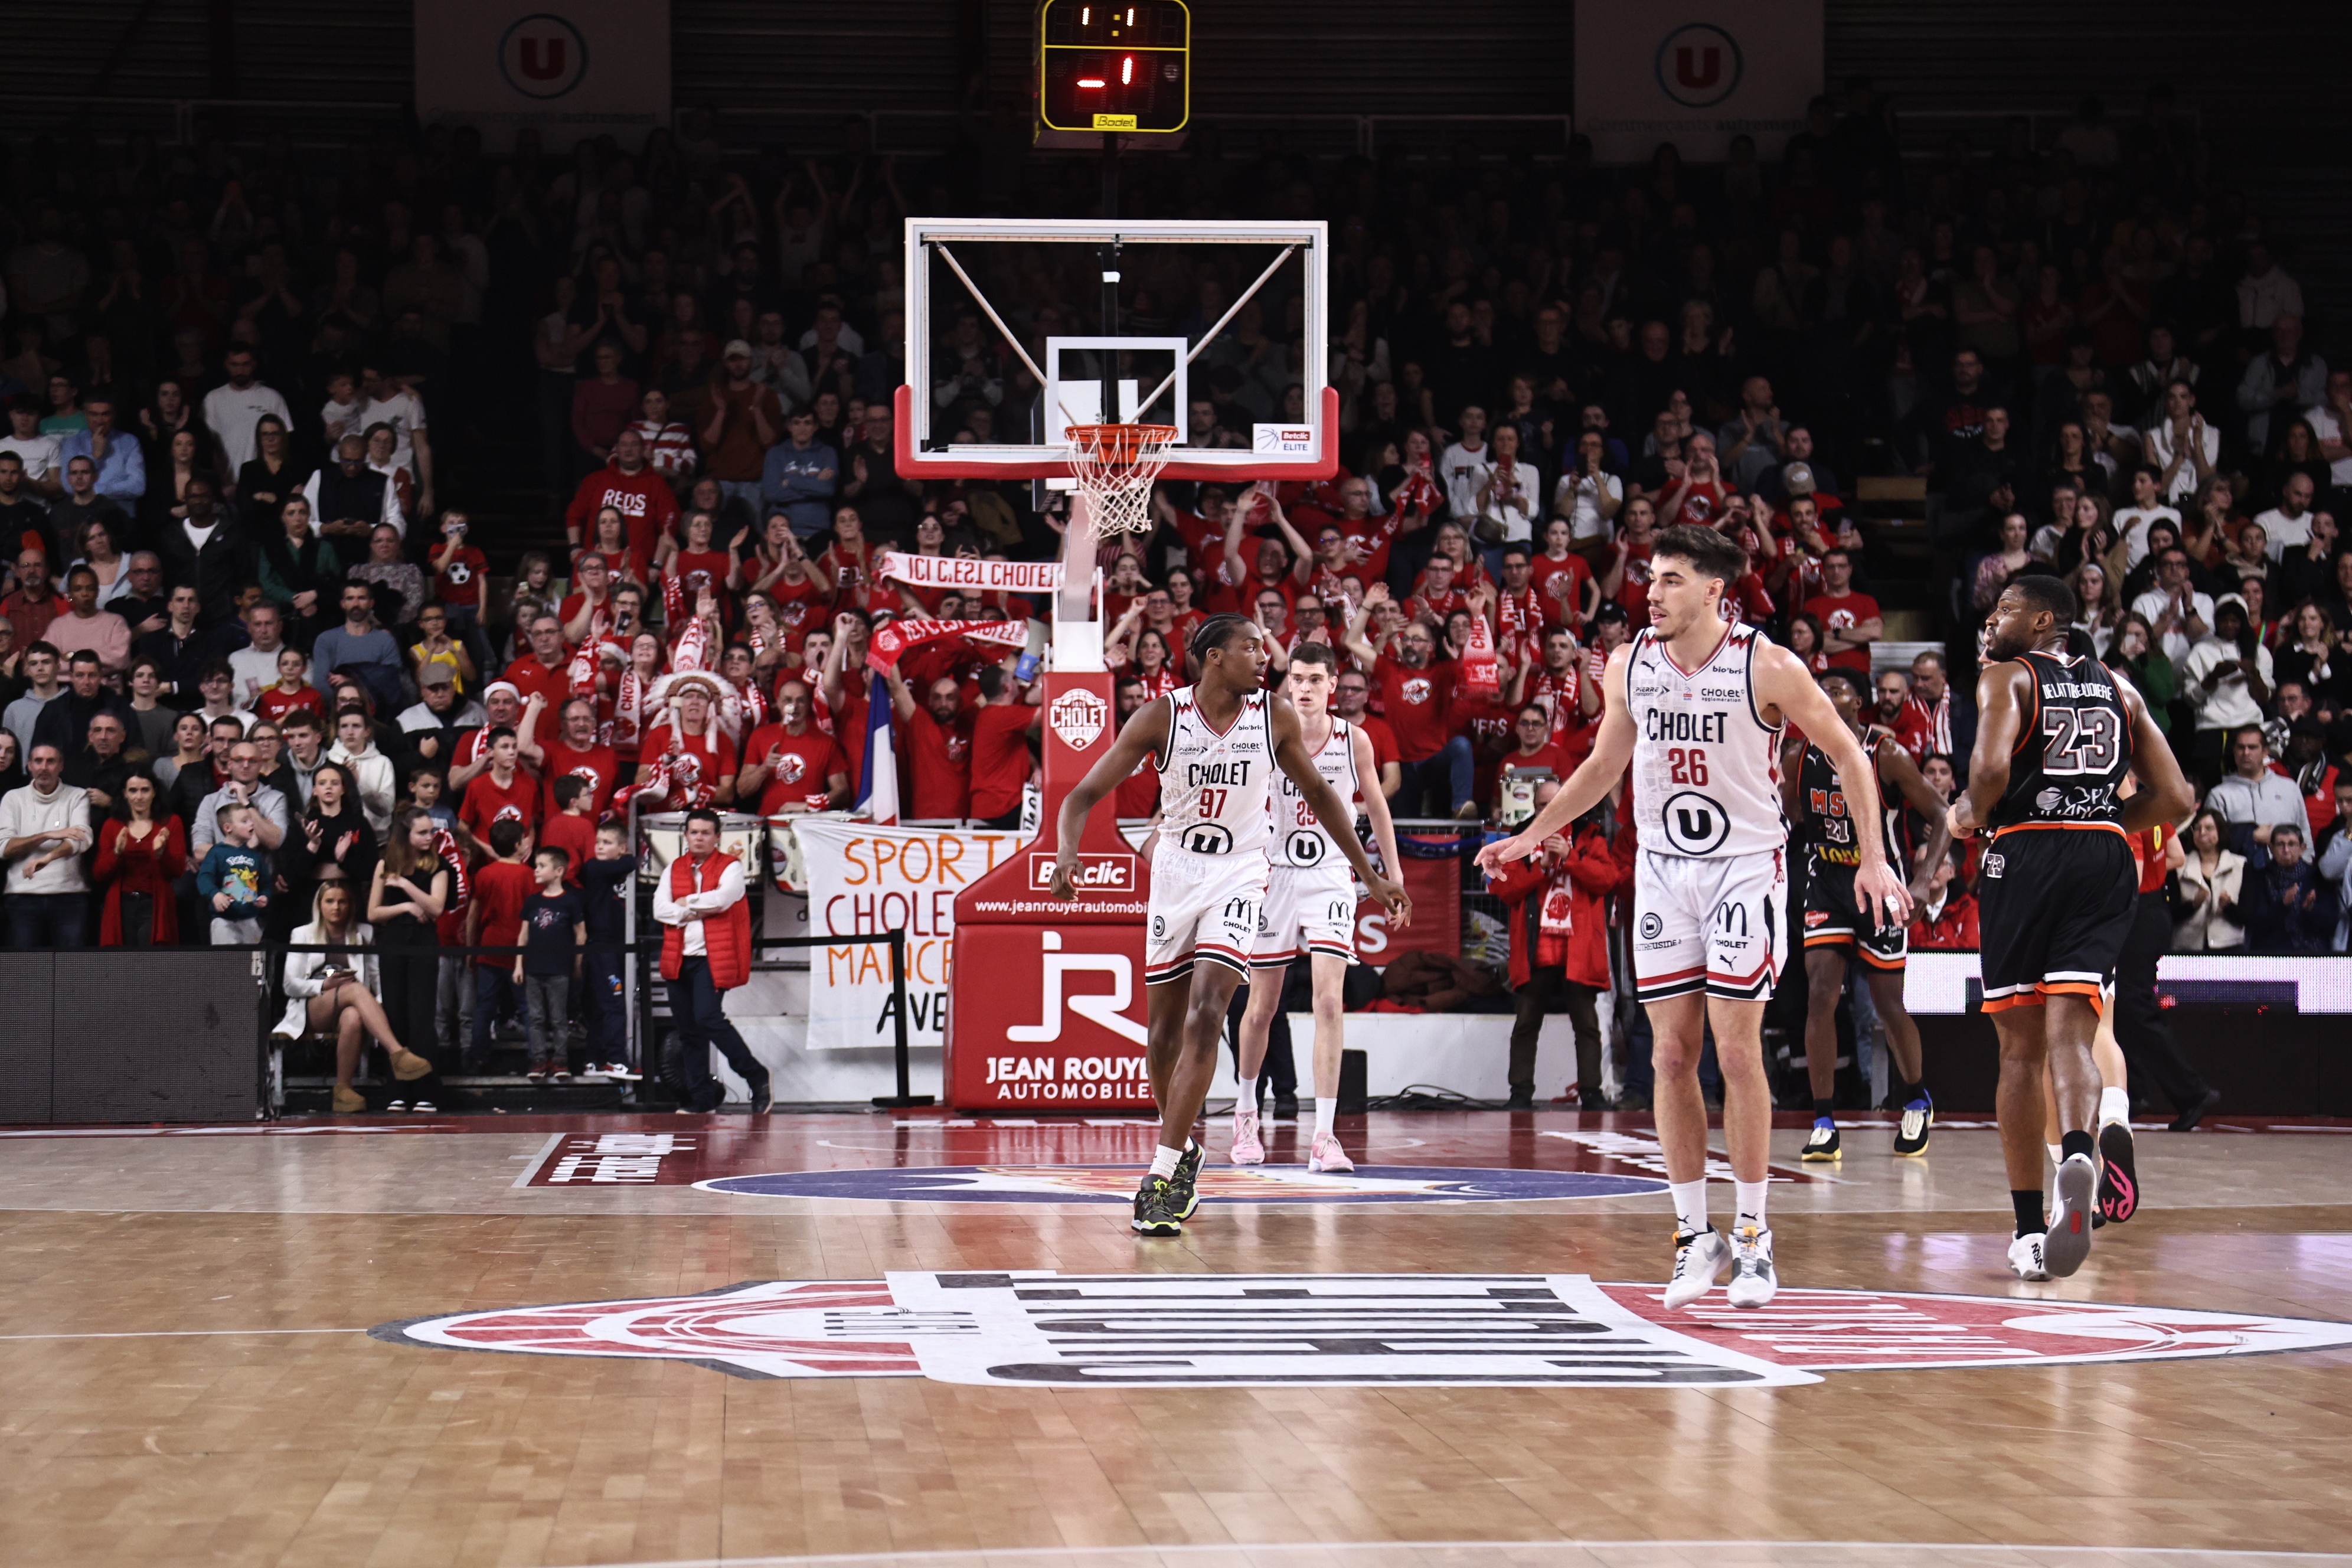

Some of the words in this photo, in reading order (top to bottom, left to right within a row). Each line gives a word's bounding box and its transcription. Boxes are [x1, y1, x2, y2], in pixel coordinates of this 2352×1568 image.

[520, 37, 566, 81] U
[1677, 46, 1721, 89] U
[1096, 116, 1135, 128] Bodet
[1716, 118, 1811, 132] autremen
[1283, 432, 1309, 440] Betclic
[1283, 441, 1308, 451] ÉLITE
[602, 489, 646, 511] REDS
[1050, 705, 1108, 729] CHOLET
[1647, 708, 1728, 744] CHOLET
[1064, 728, 1095, 737] BASKET
[2043, 706, 2121, 776] 23
[1188, 760, 1251, 788] CHOLET
[1668, 747, 1709, 786] 26
[1198, 788, 1228, 819] 97
[1676, 808, 1712, 840] U
[1825, 818, 1850, 843] 21
[844, 834, 1022, 886] SPORT
[1037, 860, 1127, 885] Bclic
[1986, 853, 2005, 879] 23
[1223, 921, 1252, 934] CHOLET
[1716, 939, 1749, 949] CHOLET
[986, 1057, 1054, 1084] JEAN
[997, 1082, 1154, 1100] AUTOMOBILE
